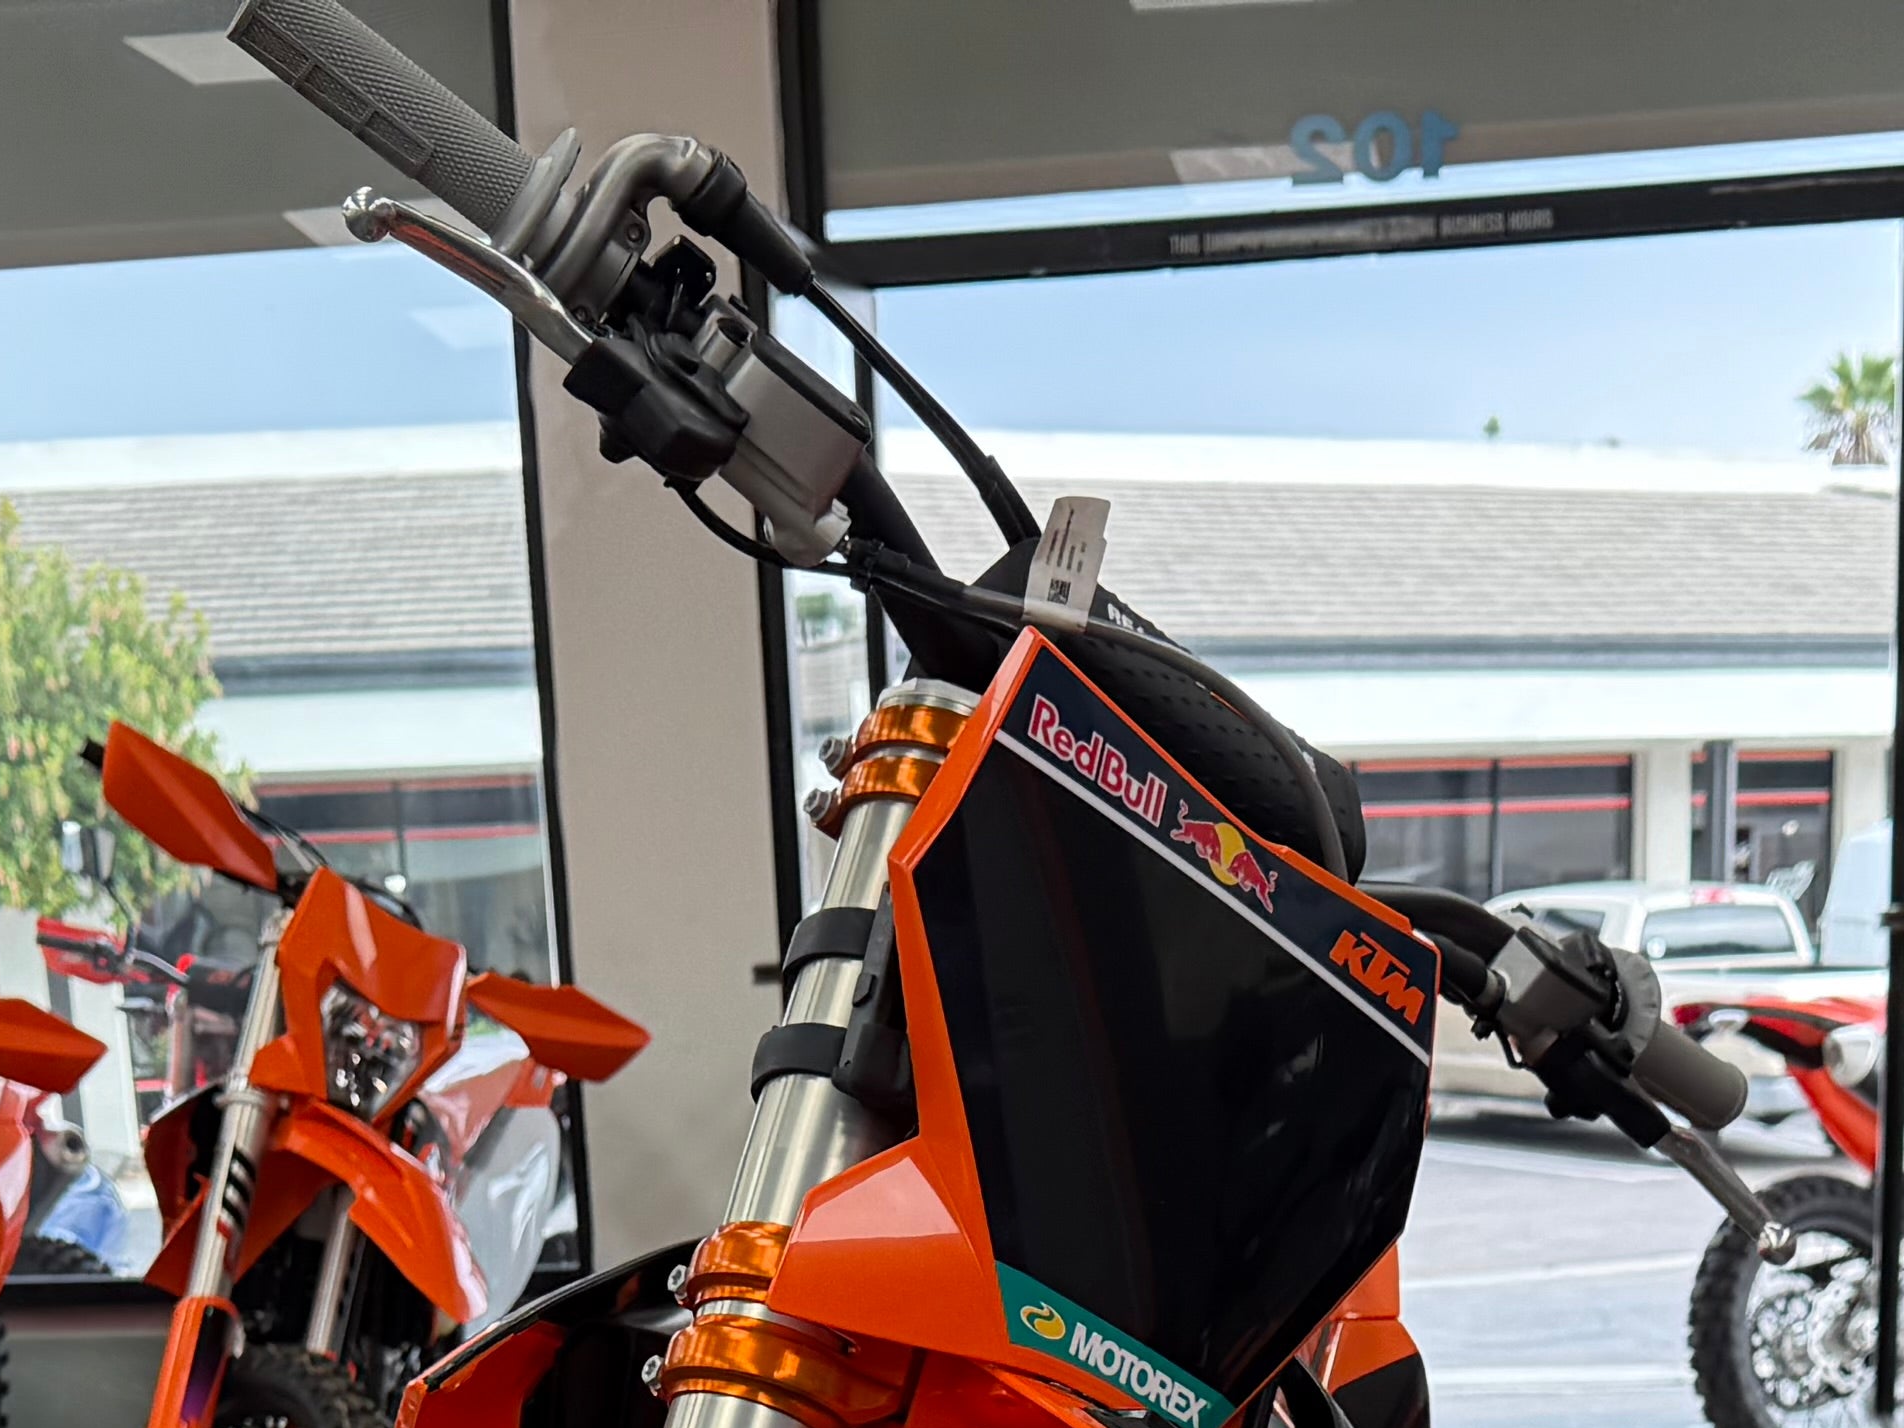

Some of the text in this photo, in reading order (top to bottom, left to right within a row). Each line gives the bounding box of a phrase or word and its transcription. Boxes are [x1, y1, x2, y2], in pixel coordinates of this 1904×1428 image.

[1027, 692, 1168, 828] Red Bull
[1329, 929, 1426, 1025] KTM
